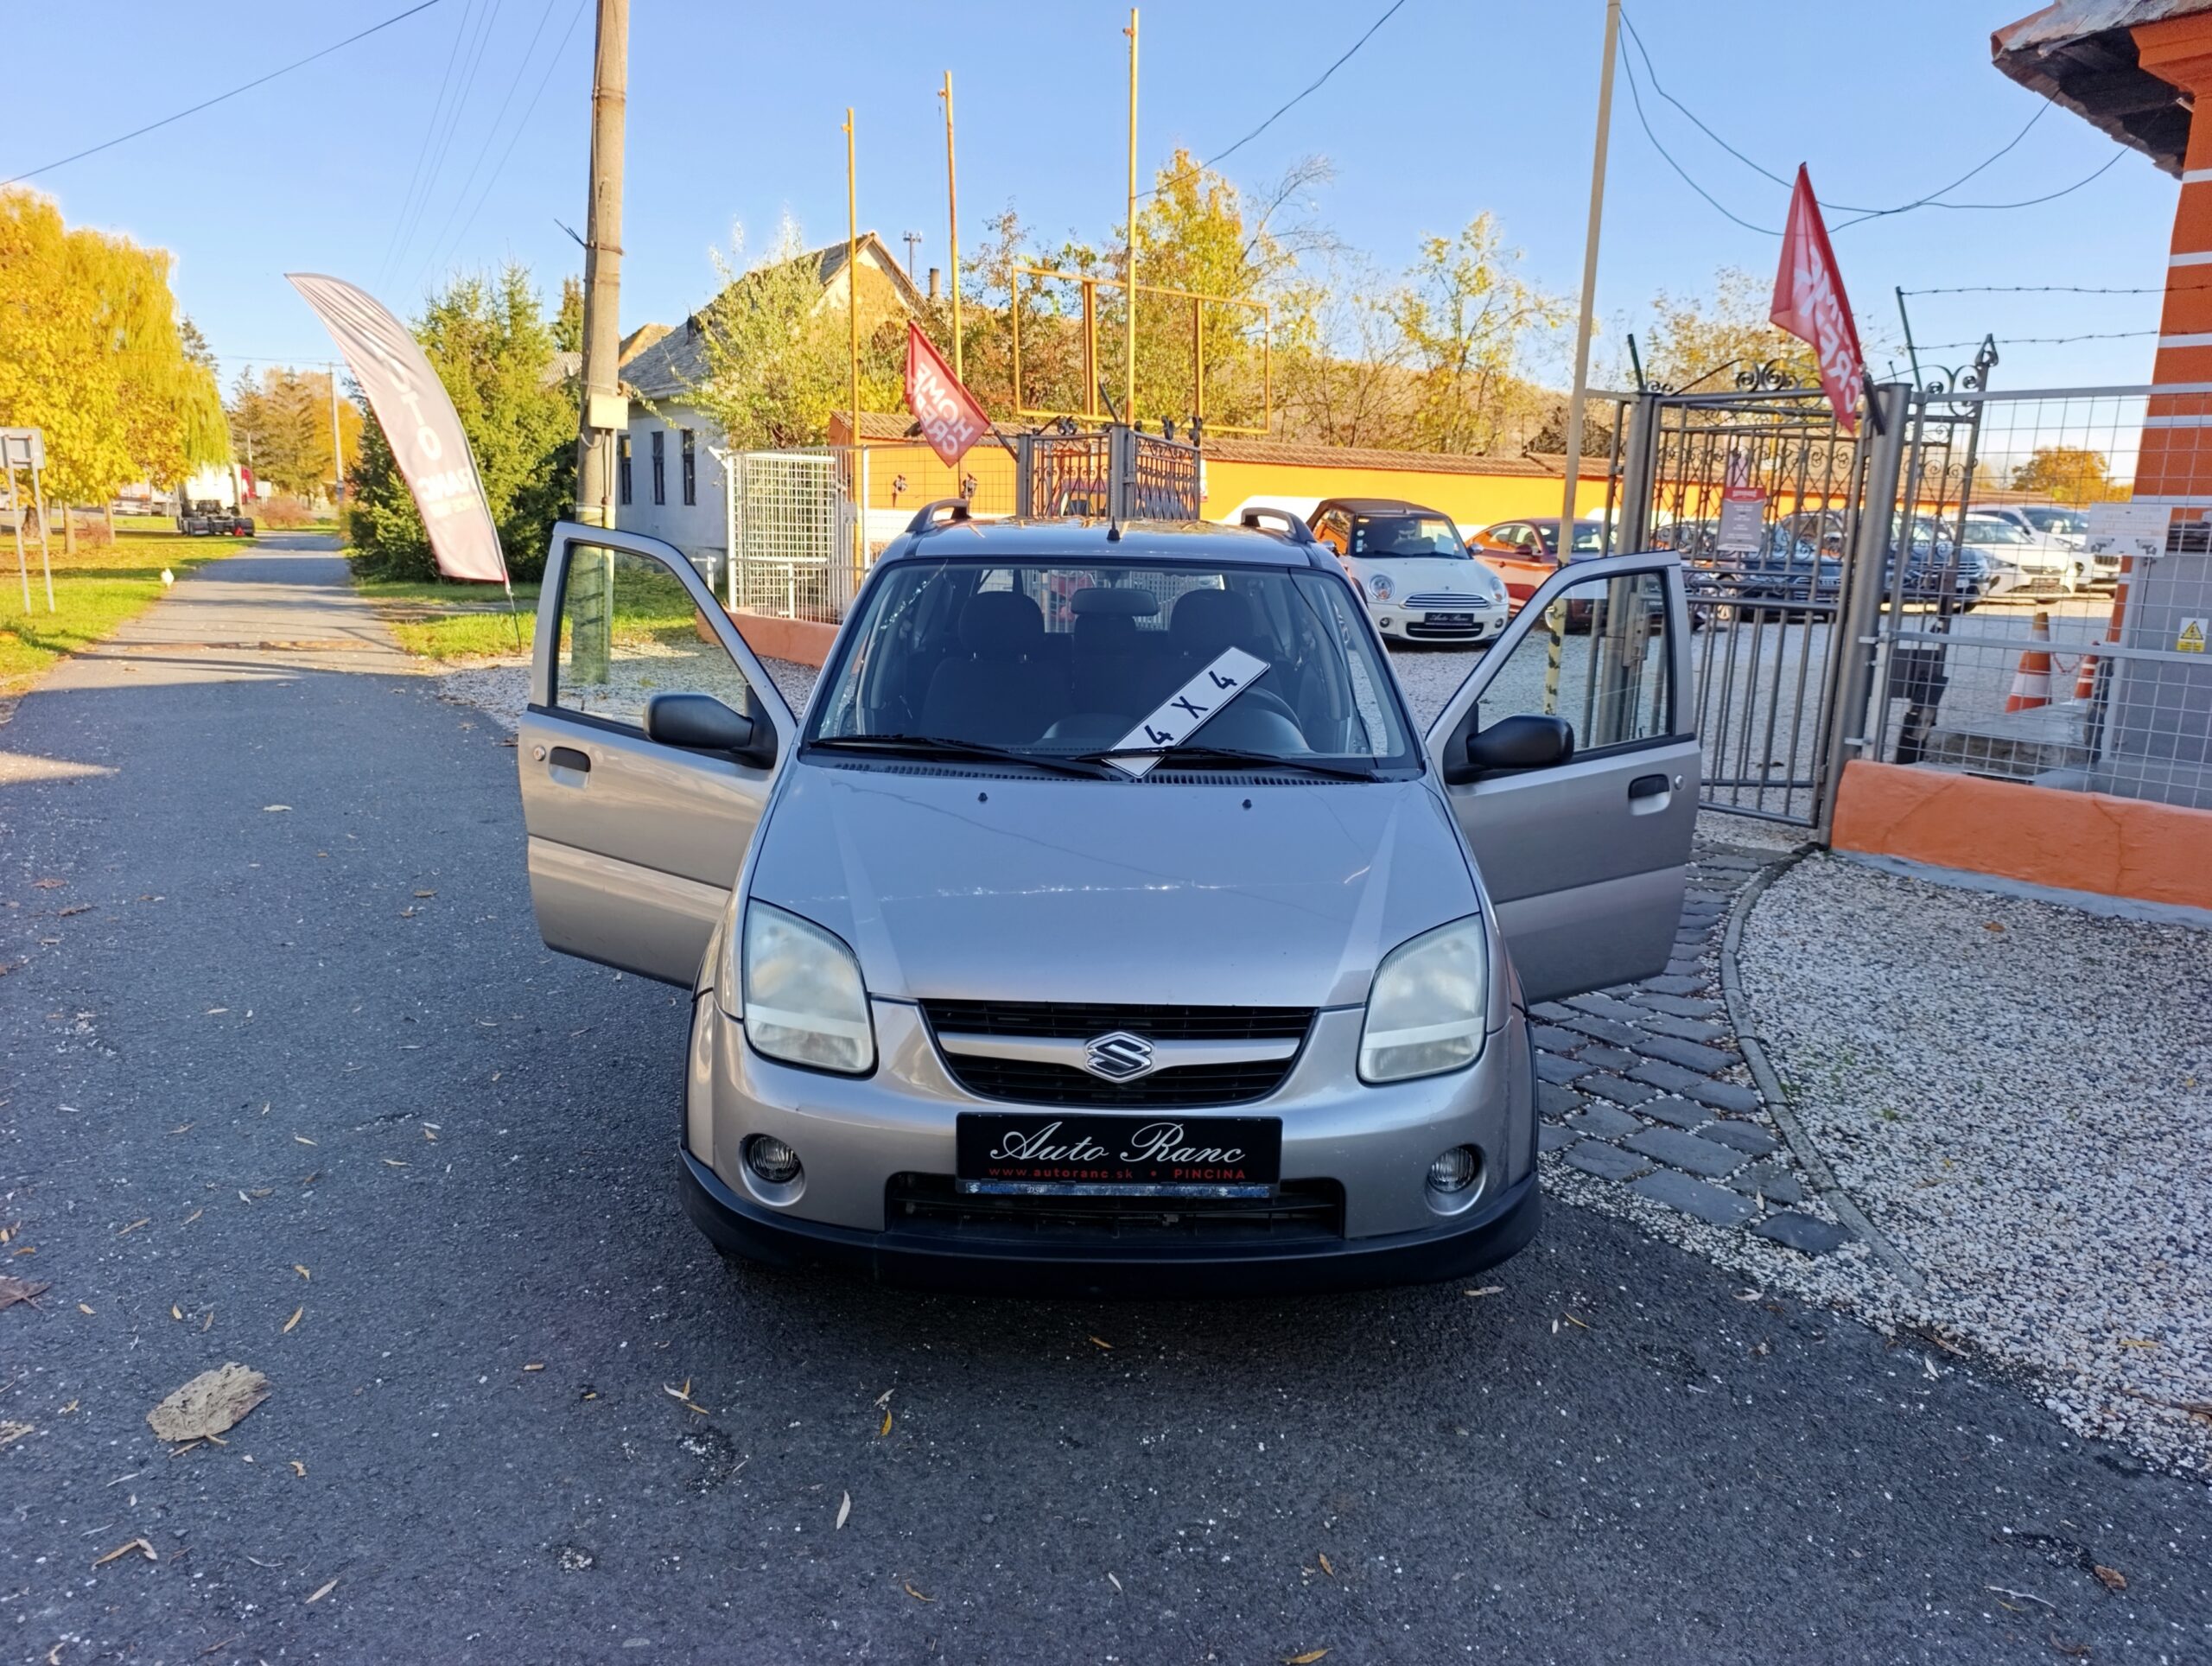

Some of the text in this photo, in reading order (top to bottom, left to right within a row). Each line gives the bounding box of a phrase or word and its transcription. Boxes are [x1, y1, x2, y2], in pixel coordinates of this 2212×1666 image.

[989, 1121, 1246, 1163] Auto Ranc
[988, 1167, 1246, 1180] www.autoranc.sk PINCINA
